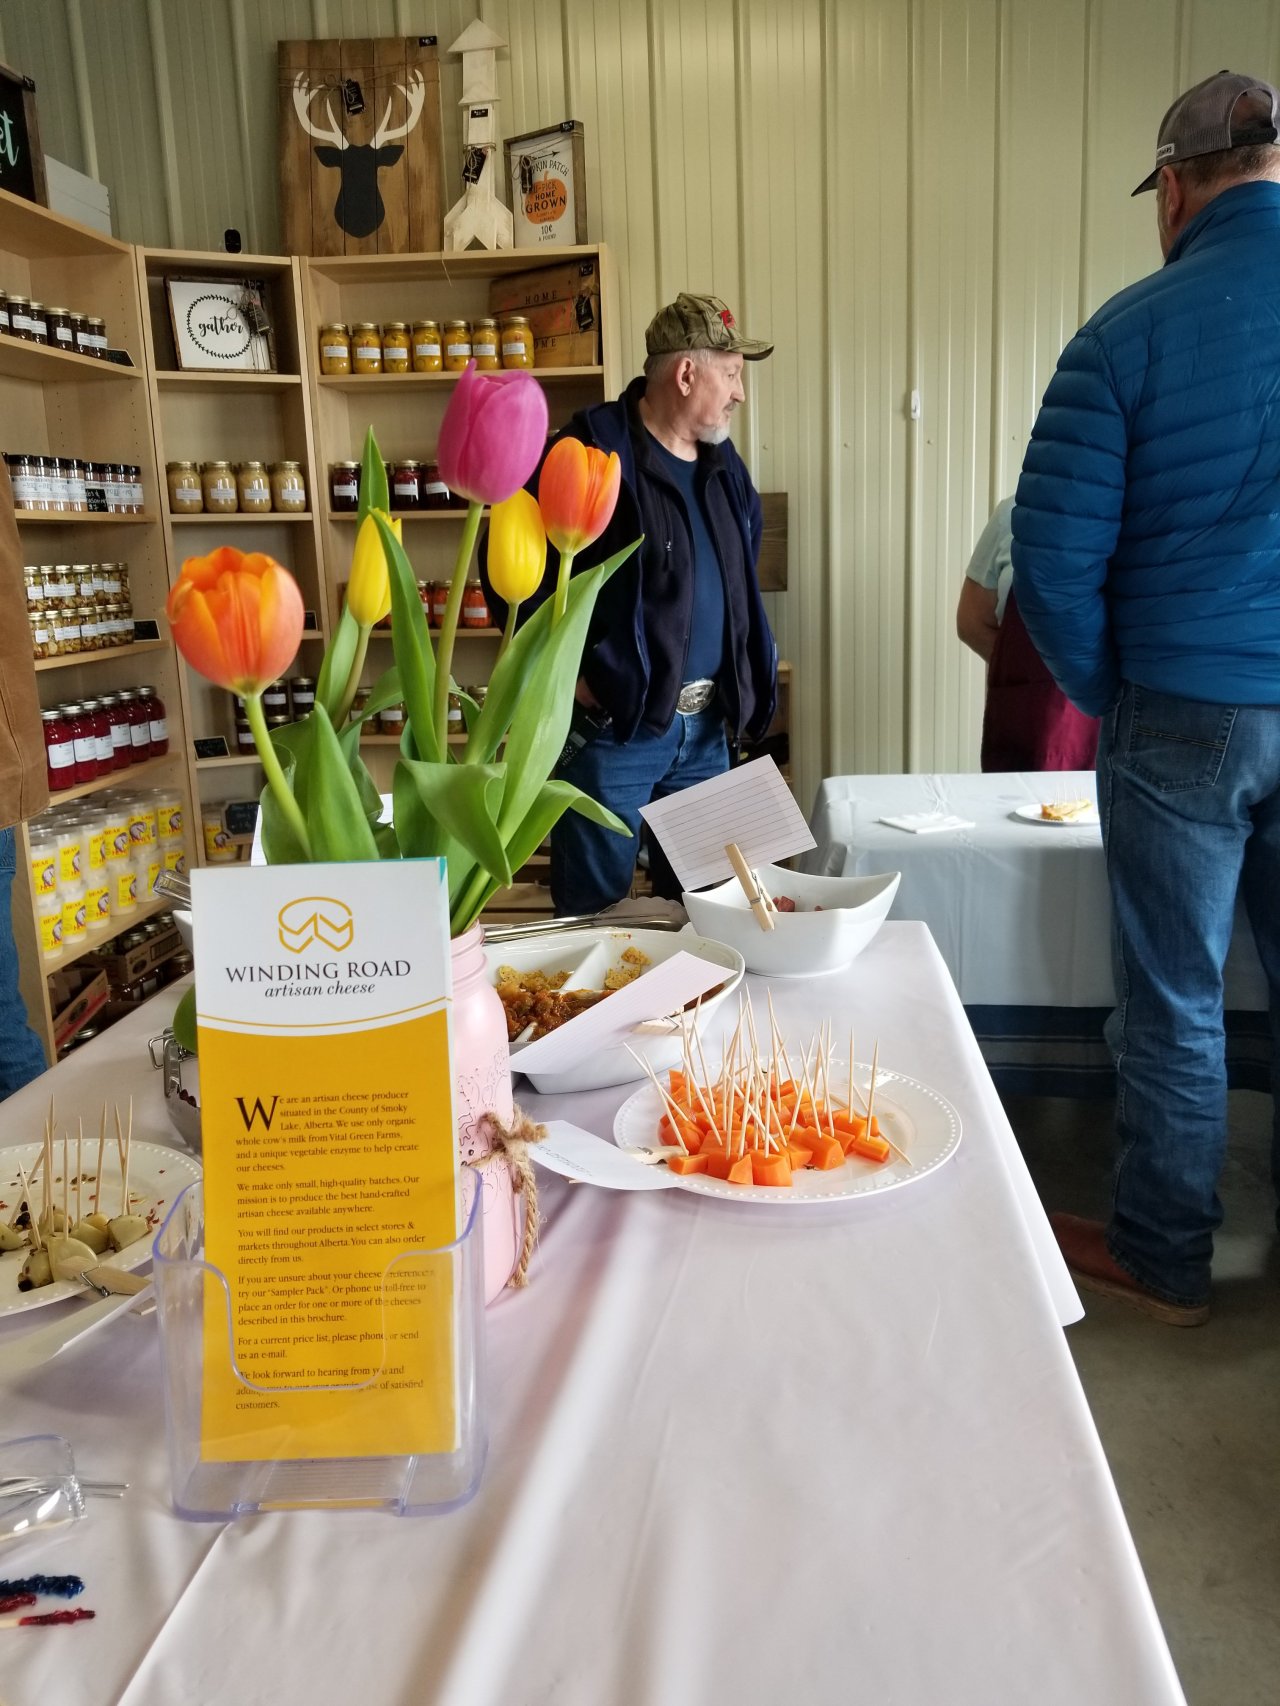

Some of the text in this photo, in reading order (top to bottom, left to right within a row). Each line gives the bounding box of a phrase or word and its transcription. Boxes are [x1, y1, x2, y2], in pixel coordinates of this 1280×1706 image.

[549, 160, 570, 177] PATCH
[535, 190, 556, 201] HOME
[526, 196, 567, 214] GROWN
[541, 224, 552, 235] 10¢
[525, 290, 558, 304] HOME
[199, 316, 244, 337] gather
[226, 960, 411, 982] WINDING ROAD
[264, 980, 376, 998] artisan cheese
[286, 1096, 298, 1104] are
[301, 1095, 310, 1103] an
[313, 1091, 339, 1102] artisan
[342, 1090, 369, 1101] cheese
[372, 1088, 408, 1102] producer
[280, 1102, 407, 1117] situated in the County of Smoky
[336, 1118, 348, 1128] We
[350, 1119, 364, 1127] use
[366, 1116, 384, 1129] only
[386, 1115, 416, 1128] organic
[236, 1134, 260, 1145] whole
[263, 1133, 286, 1144] cow's
[288, 1132, 306, 1143] milk
[309, 1132, 328, 1142] from
[329, 1131, 347, 1141] Vital
[350, 1130, 374, 1141] Green
[236, 1140, 418, 1160] and a unique vegetable enzyme to help create
[236, 1164, 250, 1172] our
[237, 1180, 249, 1191] We
[252, 1179, 273, 1190] make
[276, 1178, 292, 1192] only
[320, 1175, 366, 1190] high-quality
[404, 1173, 419, 1184] Our
[238, 1187, 410, 1205] mission is to produce the best hand-crafted
[238, 1207, 264, 1218] artisan
[266, 1206, 294, 1217] cheese
[296, 1204, 330, 1216] available
[238, 1219, 414, 1237] You will find our products in select stores &
[238, 1239, 270, 1250] markets
[272, 1237, 317, 1251] throughout
[351, 1235, 366, 1245] You
[368, 1237, 382, 1245] can
[385, 1233, 401, 1244] also
[403, 1232, 425, 1243] order
[238, 1253, 268, 1267] directly
[271, 1253, 290, 1263] from
[239, 1273, 244, 1283] If
[247, 1275, 261, 1286] you
[279, 1274, 306, 1282] unsure
[308, 1270, 330, 1281] about
[333, 1272, 352, 1282] your
[354, 1268, 382, 1279] cheese
[238, 1287, 249, 1300] try
[252, 1289, 266, 1297] our
[332, 1284, 344, 1294] Or
[346, 1283, 371, 1296] phone
[374, 1285, 382, 1293] us
[418, 1281, 426, 1291] to
[239, 1300, 260, 1314] place
[274, 1299, 296, 1310] order
[299, 1299, 310, 1309] for
[312, 1301, 328, 1309] one
[330, 1300, 339, 1308] or
[341, 1300, 362, 1308] more
[364, 1297, 373, 1307] of
[390, 1295, 421, 1306] cheeses
[238, 1314, 278, 1325] described
[280, 1313, 288, 1324] in
[290, 1313, 305, 1323] this
[238, 1334, 252, 1345] For
[261, 1333, 290, 1344] current
[293, 1333, 314, 1346] price
[332, 1331, 357, 1344] please
[400, 1329, 418, 1340] send
[249, 1351, 259, 1359] an
[253, 1368, 270, 1379] look
[273, 1367, 304, 1378] forward
[307, 1367, 315, 1377] to
[318, 1366, 348, 1379] hearing
[351, 1365, 370, 1376] from
[389, 1364, 404, 1375] and
[380, 1379, 389, 1389] of
[391, 1378, 423, 1389] satisfied
